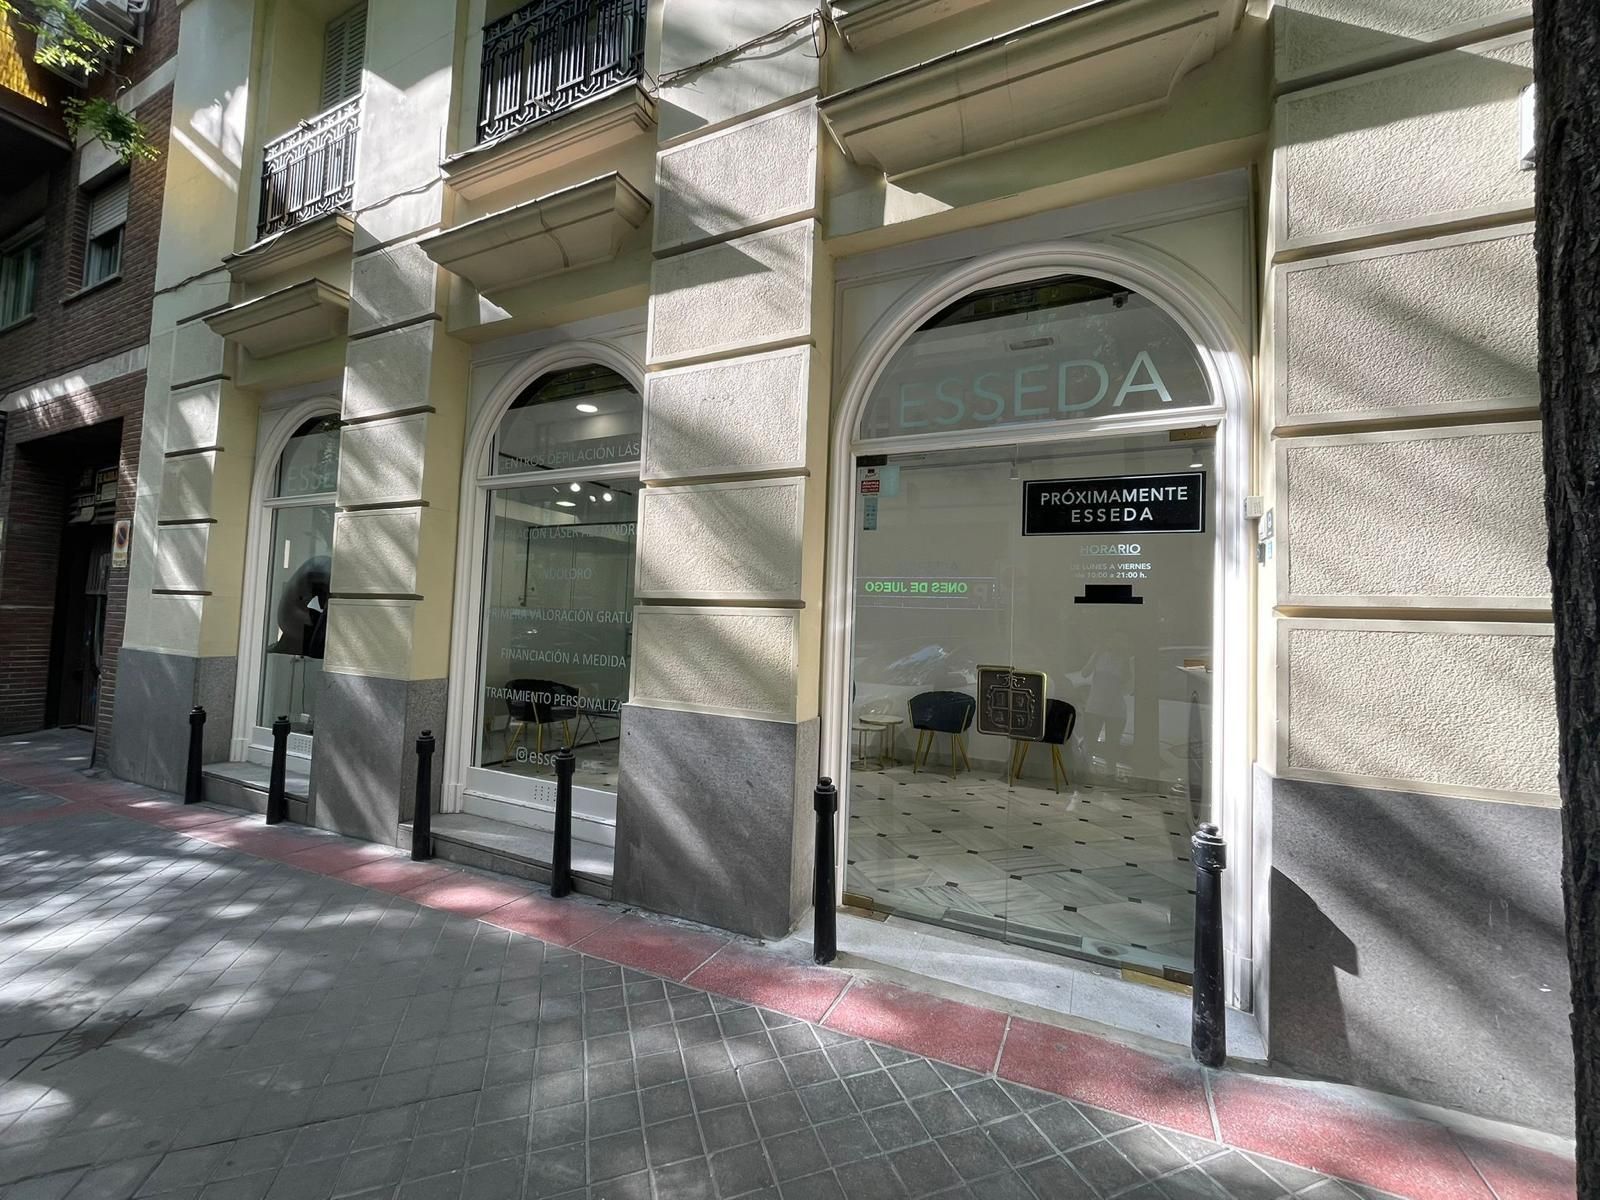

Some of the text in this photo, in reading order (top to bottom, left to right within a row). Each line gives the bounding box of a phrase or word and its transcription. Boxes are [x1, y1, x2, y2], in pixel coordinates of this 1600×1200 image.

[898, 350, 1172, 429] ESSEDA
[1040, 486, 1188, 506] PRÓXIMAMENTE
[1071, 507, 1153, 523] ESSEDA
[1080, 543, 1141, 555] HORARIO
[529, 606, 593, 623] VALORACIÓN
[500, 647, 626, 668] FINANCIACIÓN A MEDIDA
[486, 686, 551, 705] TRATAMIENTO
